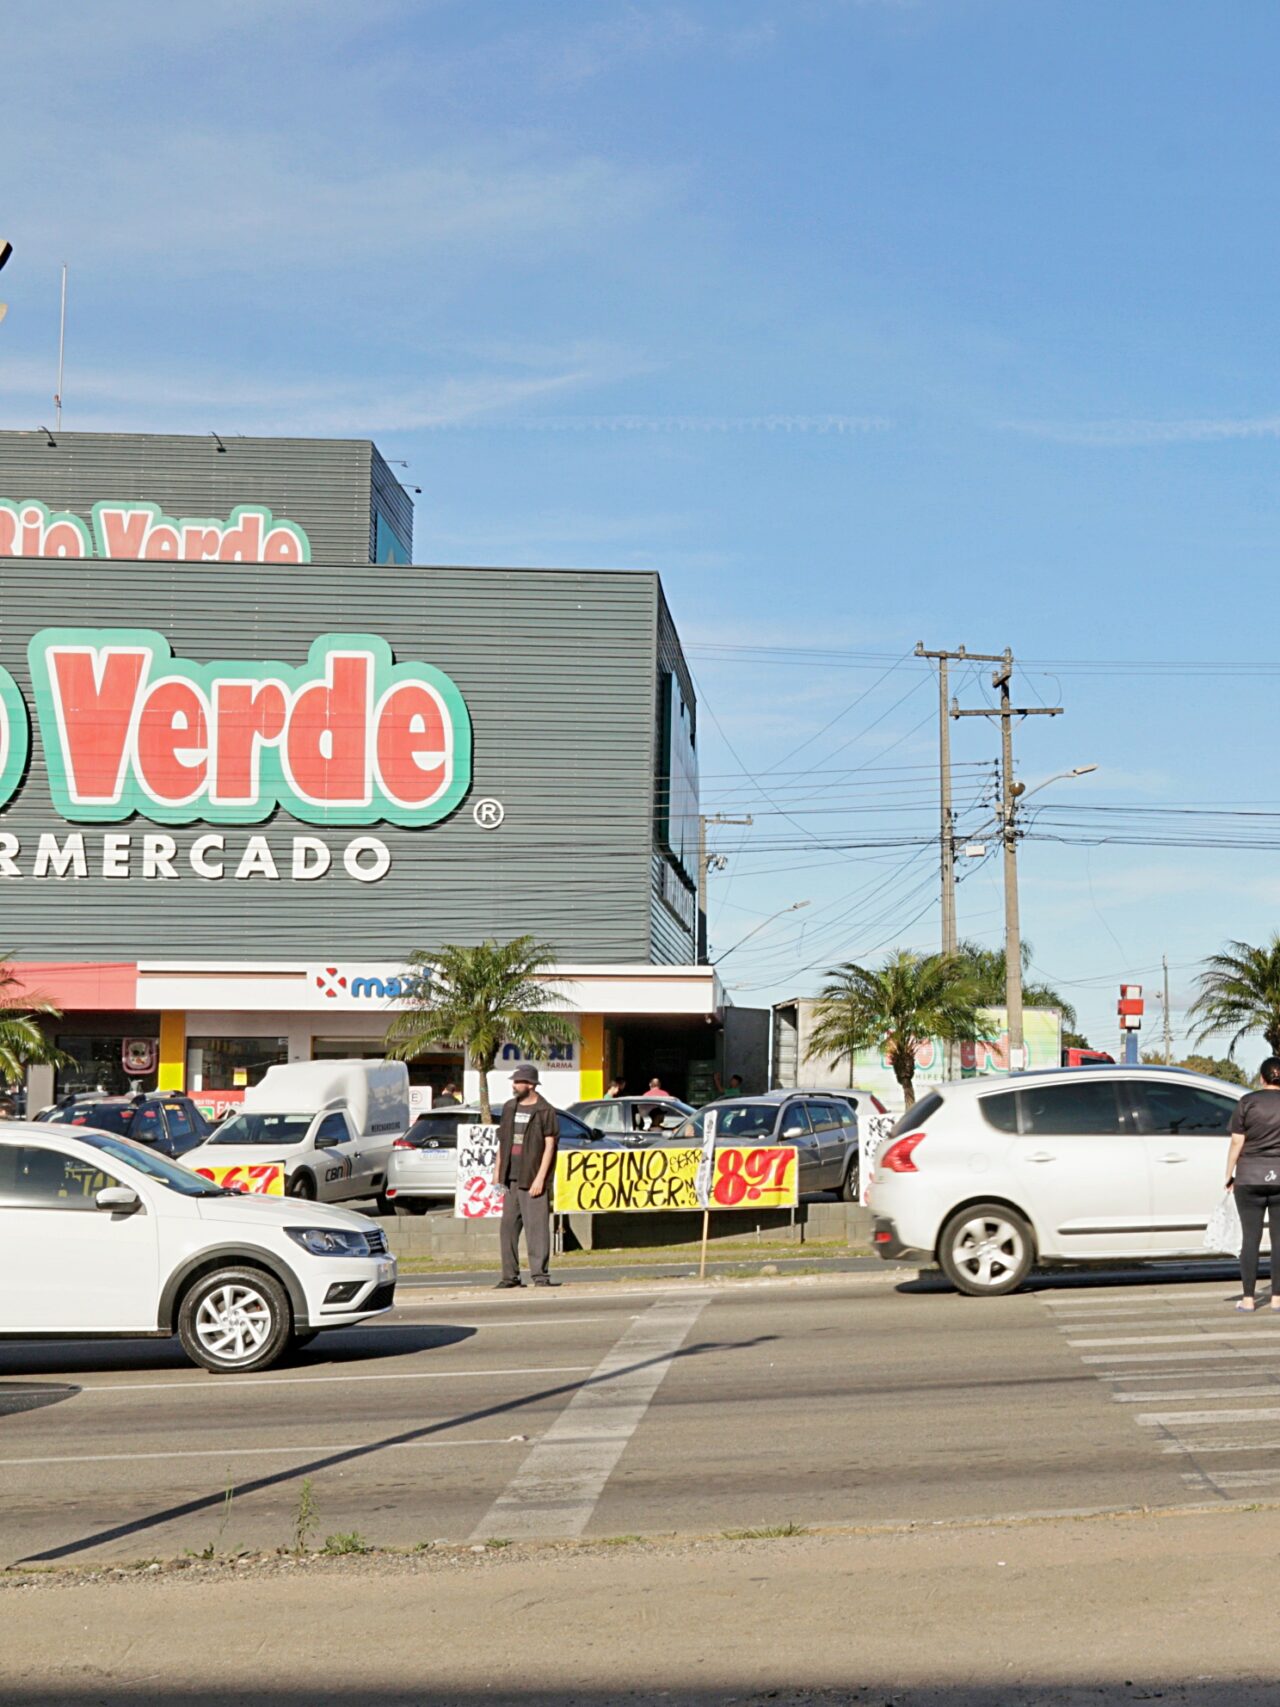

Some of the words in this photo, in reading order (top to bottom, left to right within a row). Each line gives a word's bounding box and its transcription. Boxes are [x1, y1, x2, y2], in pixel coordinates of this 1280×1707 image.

[100, 509, 303, 562] Verde
[45, 645, 454, 810] Verde
[567, 1150, 668, 1182] PEPINO
